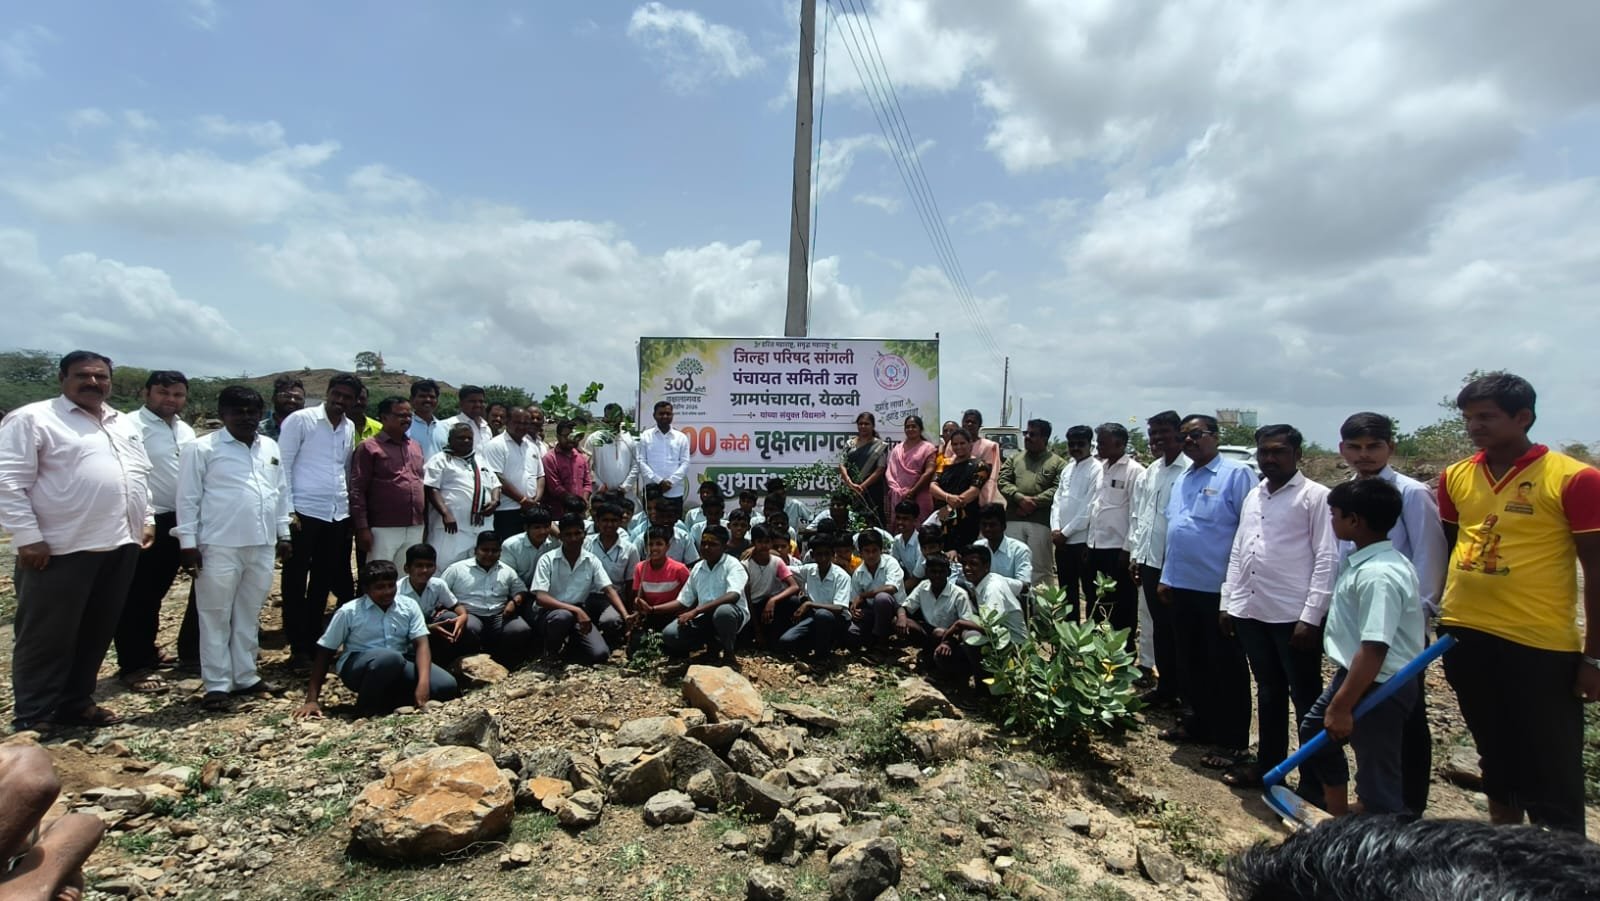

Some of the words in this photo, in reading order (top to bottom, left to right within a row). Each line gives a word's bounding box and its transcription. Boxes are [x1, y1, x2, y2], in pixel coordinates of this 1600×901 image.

[733, 348, 769, 365] जिल्हा
[773, 348, 810, 365] परिषद
[814, 348, 854, 364] सांगली
[664, 377, 694, 392] 300
[733, 368, 782, 385] पंचायत
[786, 368, 830, 385] समिती
[834, 372, 858, 385] जत
[730, 389, 815, 407] ग्रामपंचायत,
[818, 389, 860, 406] येळवी
[680, 426, 717, 456] 00
[720, 433, 750, 451] कोटी
[754, 431, 860, 459] वृक्षलागव
[717, 468, 785, 497] शुभारं
